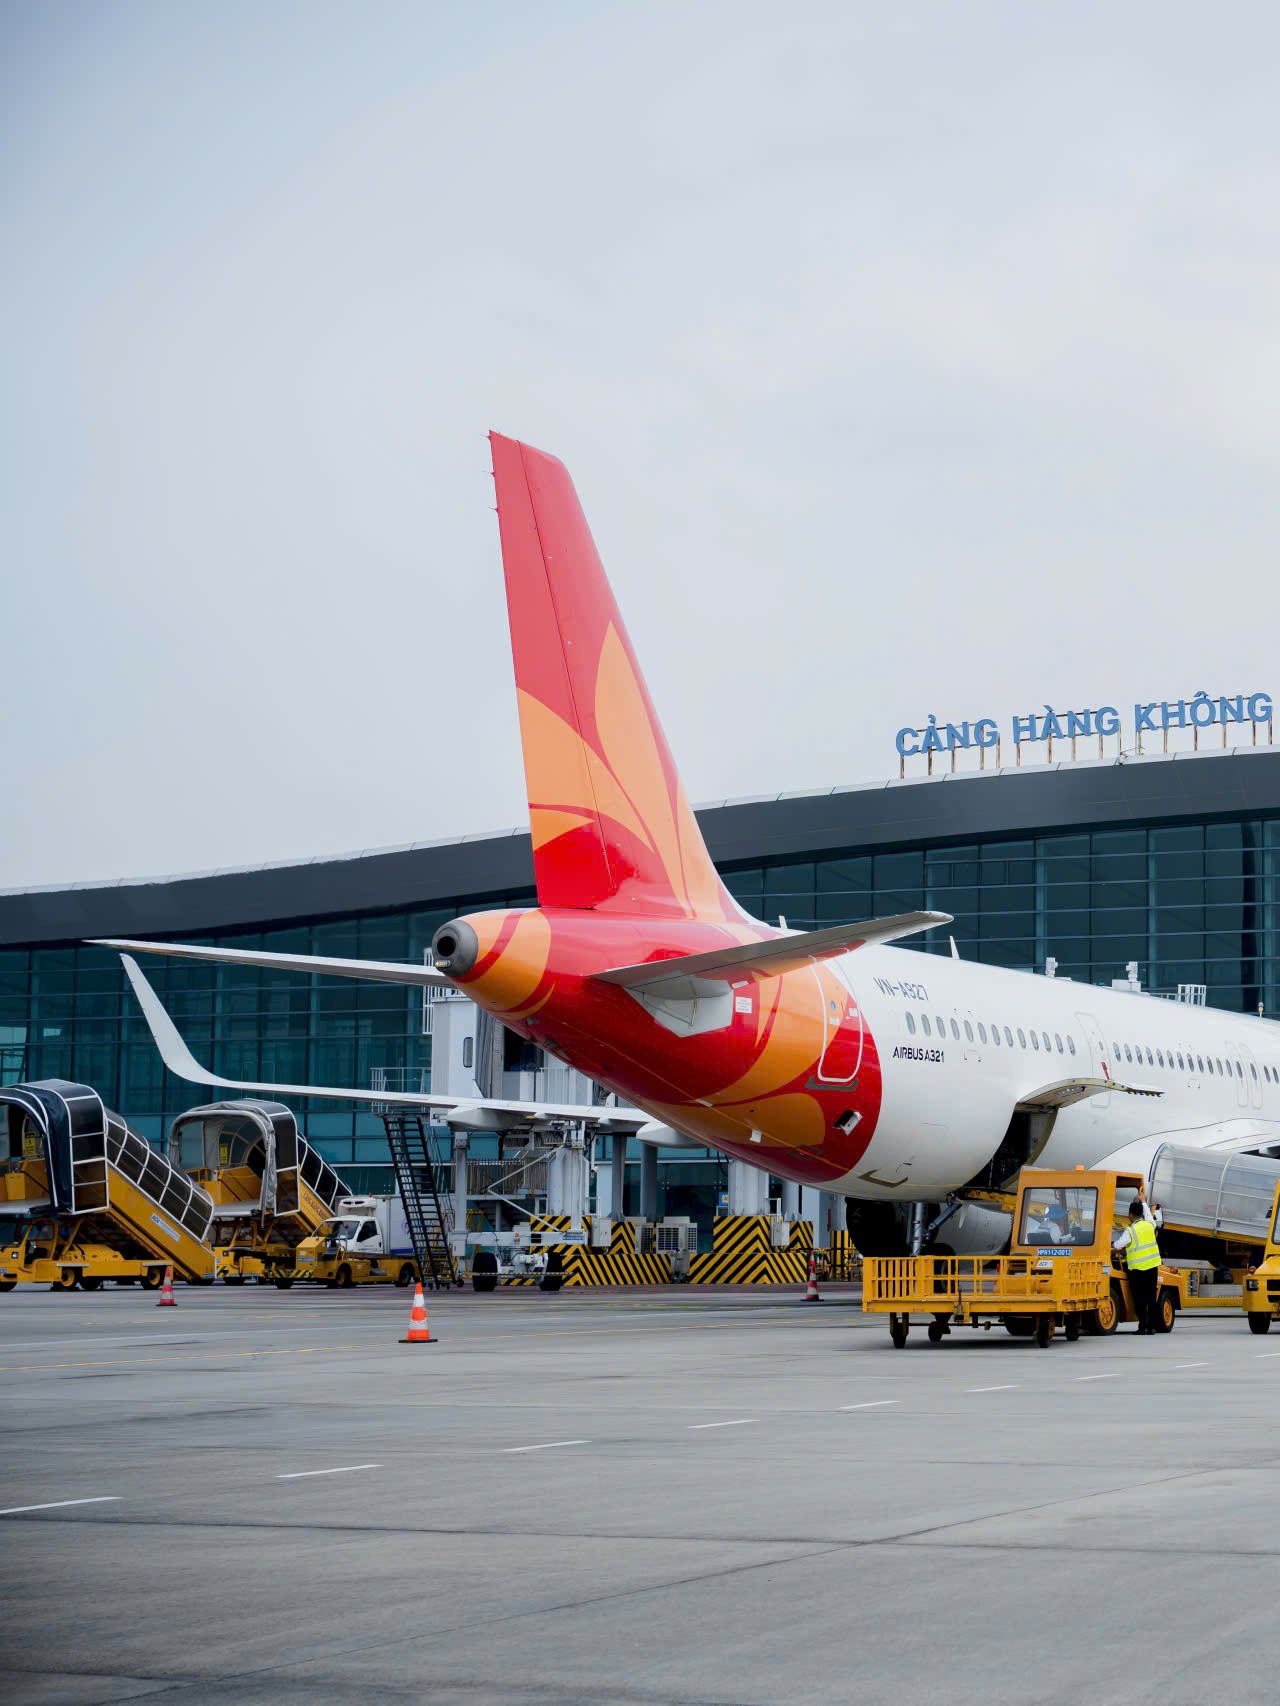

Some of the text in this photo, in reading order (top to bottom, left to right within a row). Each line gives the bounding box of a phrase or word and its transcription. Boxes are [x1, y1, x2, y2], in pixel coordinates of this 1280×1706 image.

[896, 714, 998, 756] CẢNG
[1013, 705, 1120, 744] HÀNG
[1134, 690, 1272, 732] KHÔNG
[873, 977, 928, 1000] VN-A927
[893, 1046, 944, 1063] AIRBUS A321
